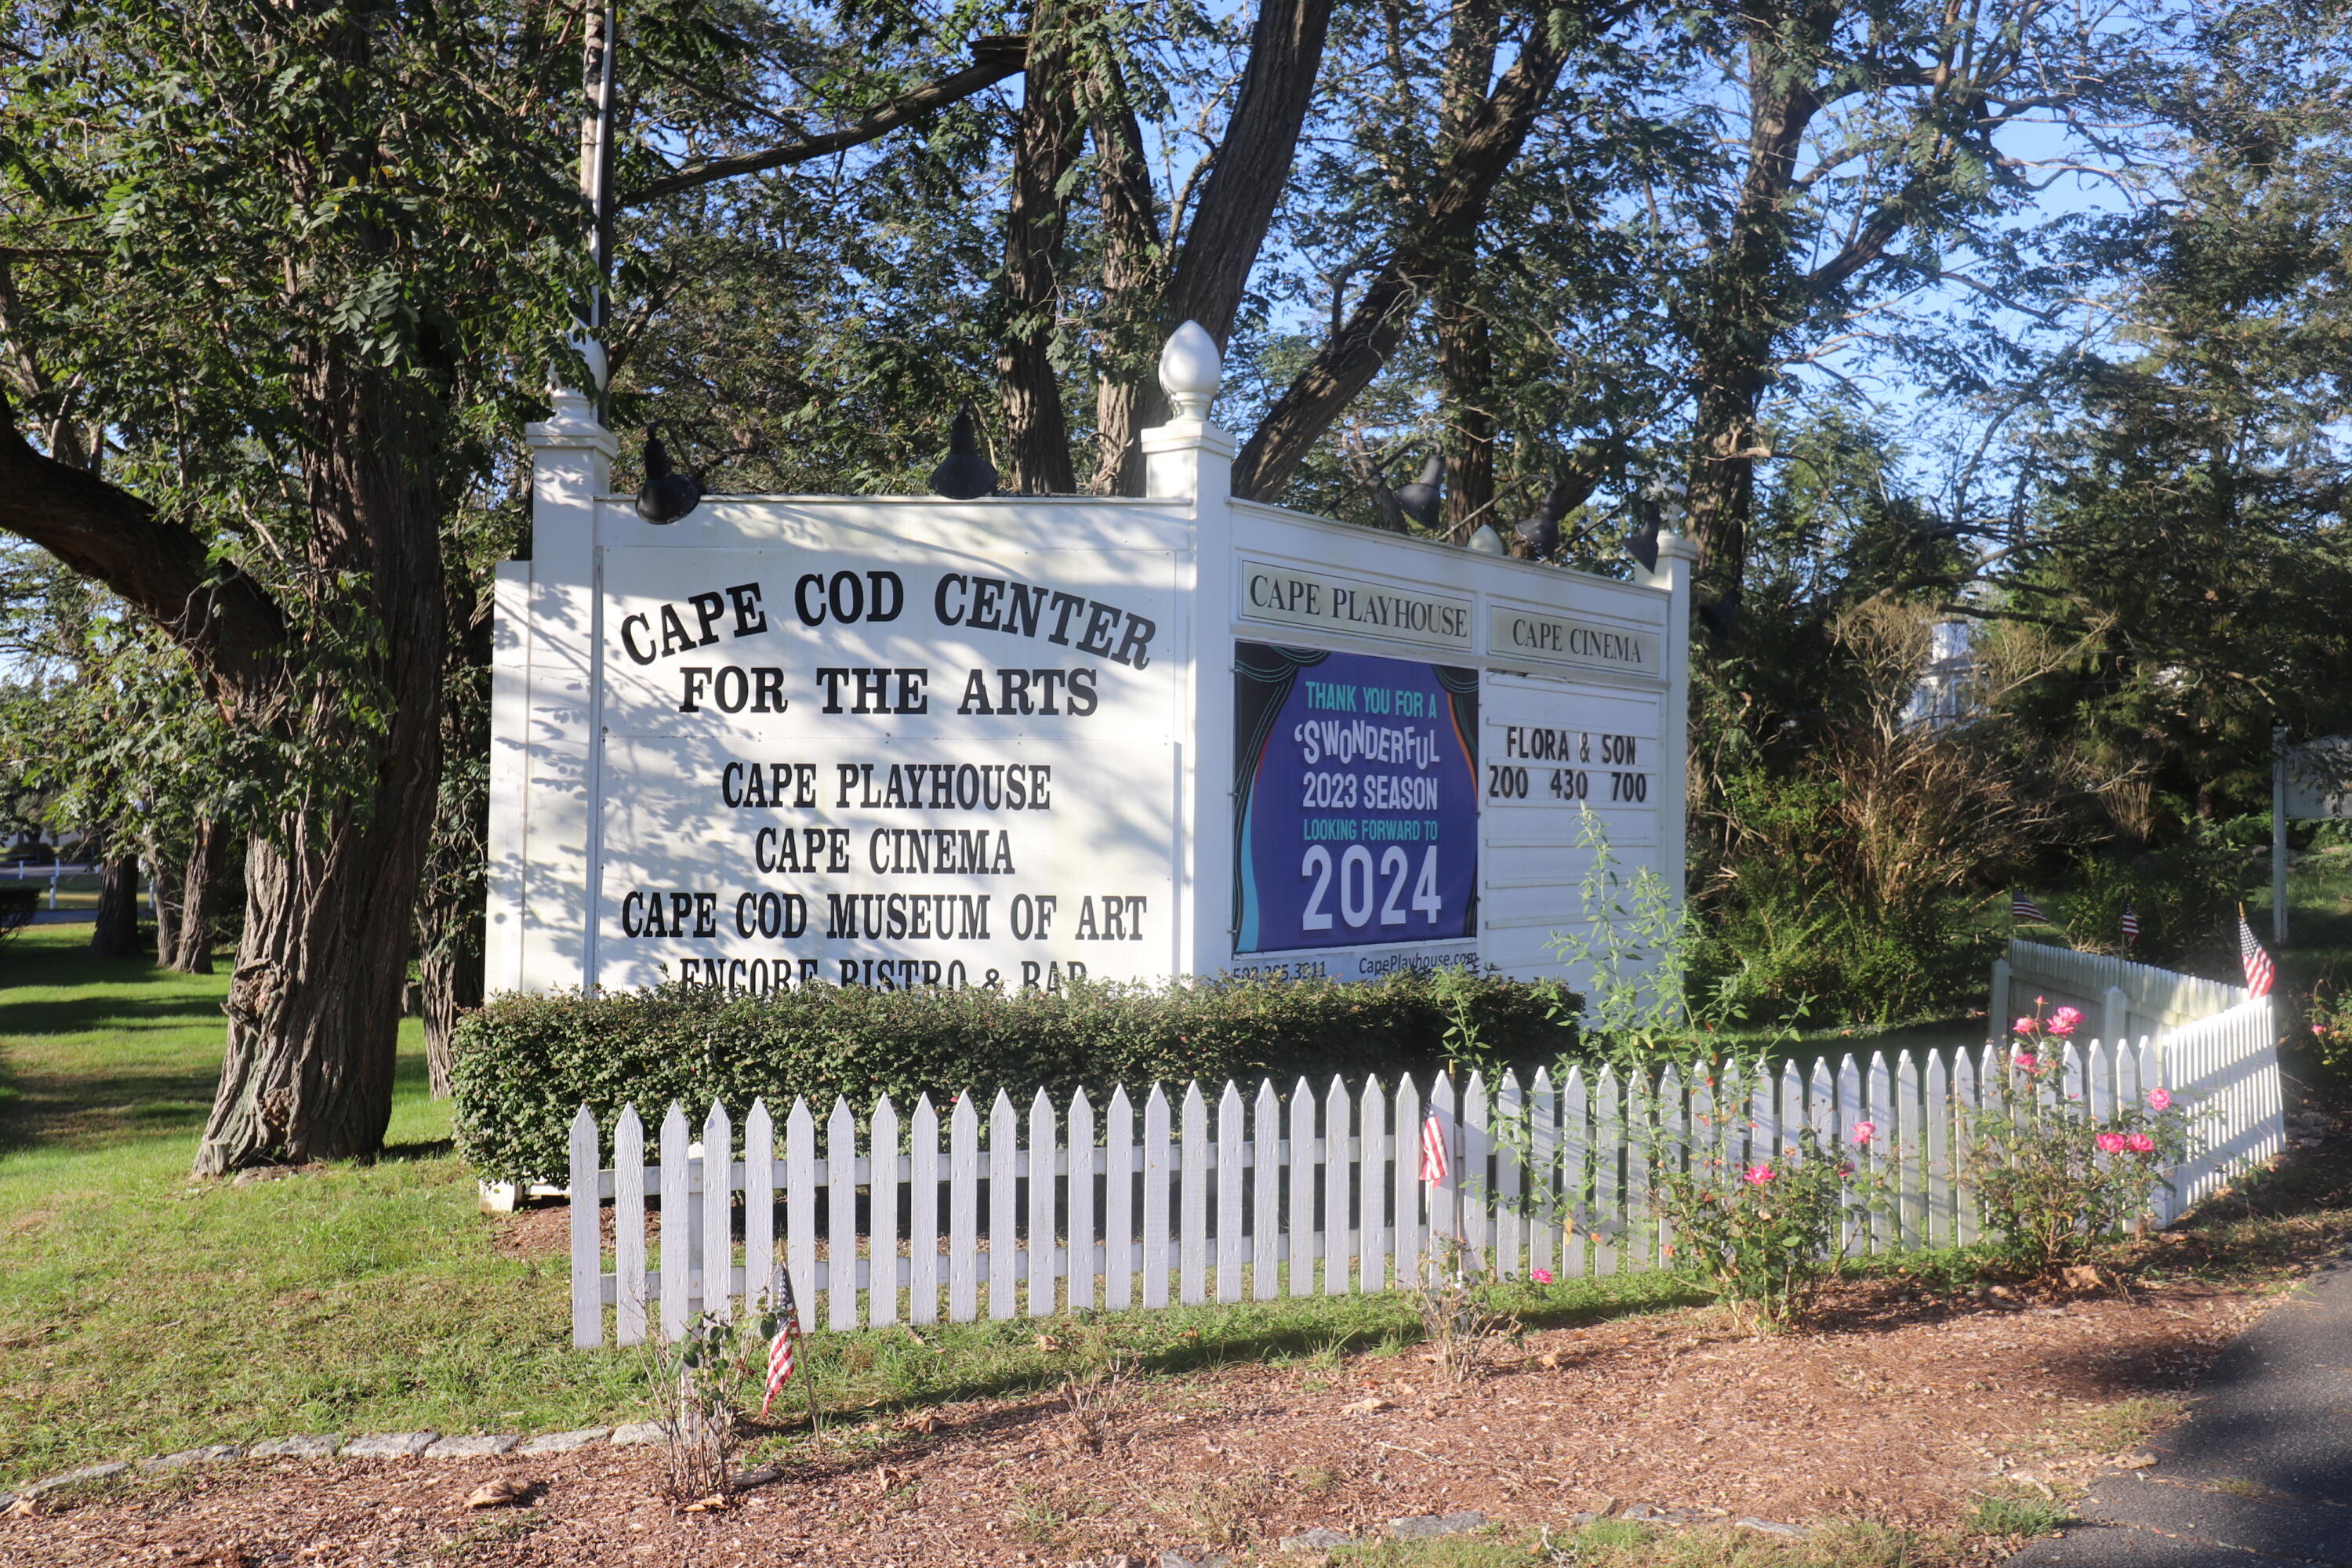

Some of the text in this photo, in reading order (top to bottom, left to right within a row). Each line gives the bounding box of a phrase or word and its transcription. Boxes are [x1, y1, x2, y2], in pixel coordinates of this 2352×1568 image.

[620, 570, 1156, 670] CAPE COD CENTER
[1250, 575, 1468, 637] CAPE PLAYHOUSE
[1513, 619, 1642, 663] CAPE CINEMA
[679, 666, 1098, 717] FOR THE ARTS
[1305, 681, 1437, 719] THANK YOU FOR A
[1507, 727, 1635, 765] FLORA & SON
[722, 763, 1051, 811] CAPE PLAYHOUSE
[1302, 771, 1438, 810] 2023 SEASON
[1489, 765, 1646, 802] 200 430 700
[755, 827, 1015, 875] CAPE CINEMA
[1304, 818, 1438, 840] LOOKING FORWARD TO
[1301, 844, 1442, 931] 2024
[622, 891, 1147, 941] CAPE COD MUSEUM OF ART
